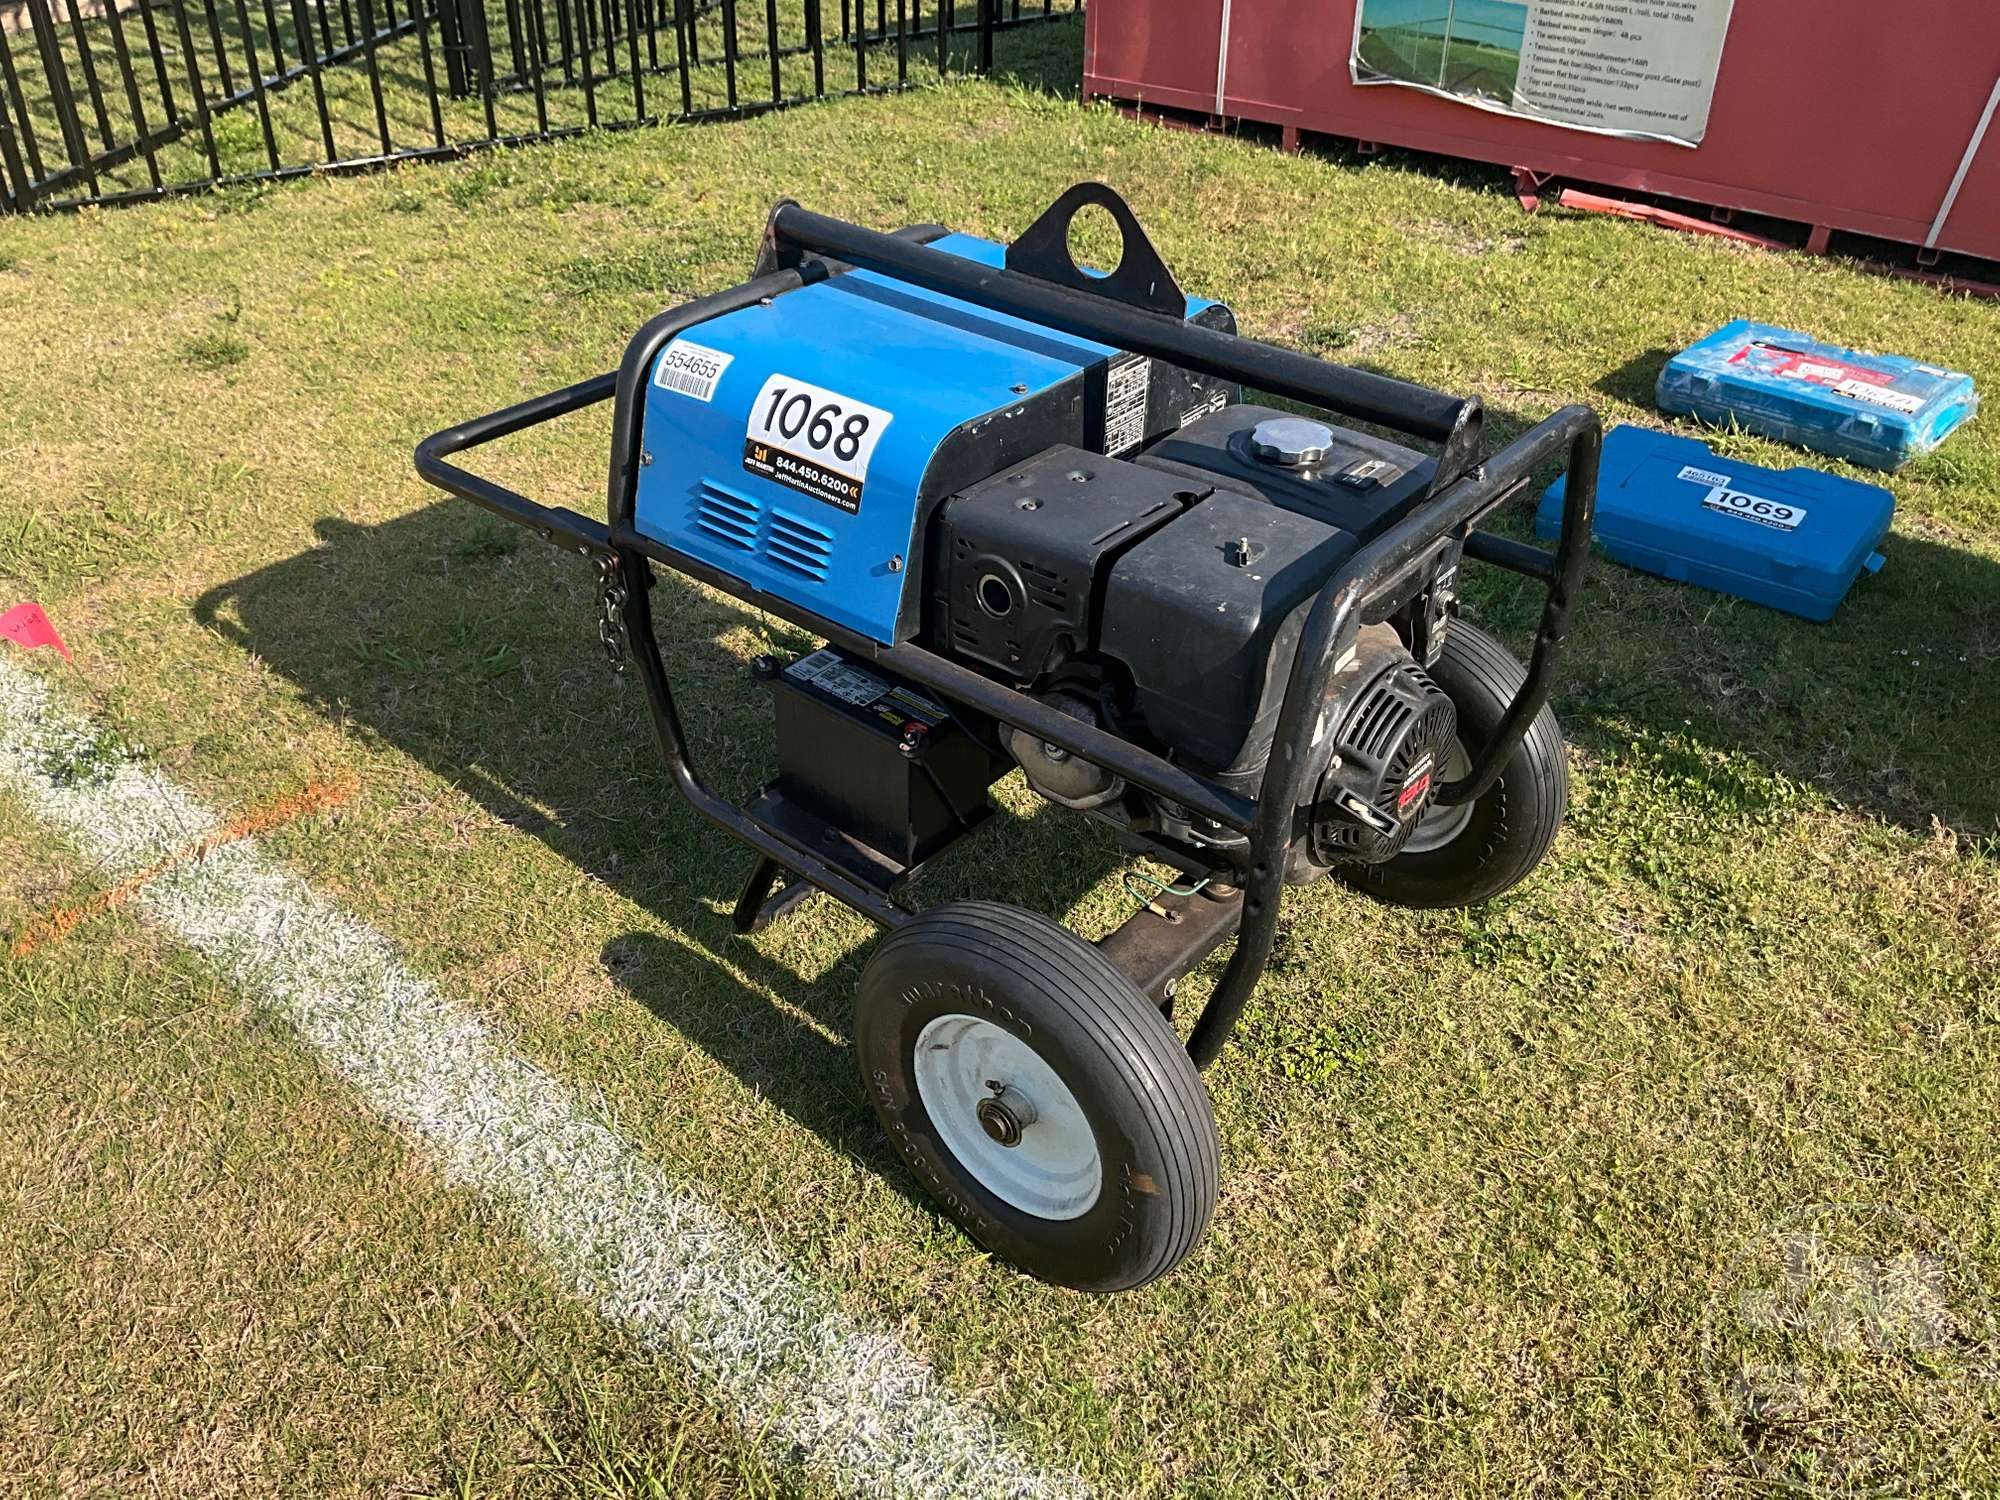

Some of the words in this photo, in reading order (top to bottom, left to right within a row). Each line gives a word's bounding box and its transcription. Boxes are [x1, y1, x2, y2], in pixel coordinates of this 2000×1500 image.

[1634, 108, 1667, 118] complete
[666, 350, 720, 379] 554655
[764, 388, 870, 462] 1068
[774, 470, 857, 511] JeffMartinAuctioneers.com
[775, 456, 849, 495] 844.450.6200
[1719, 491, 1794, 521] 1069
